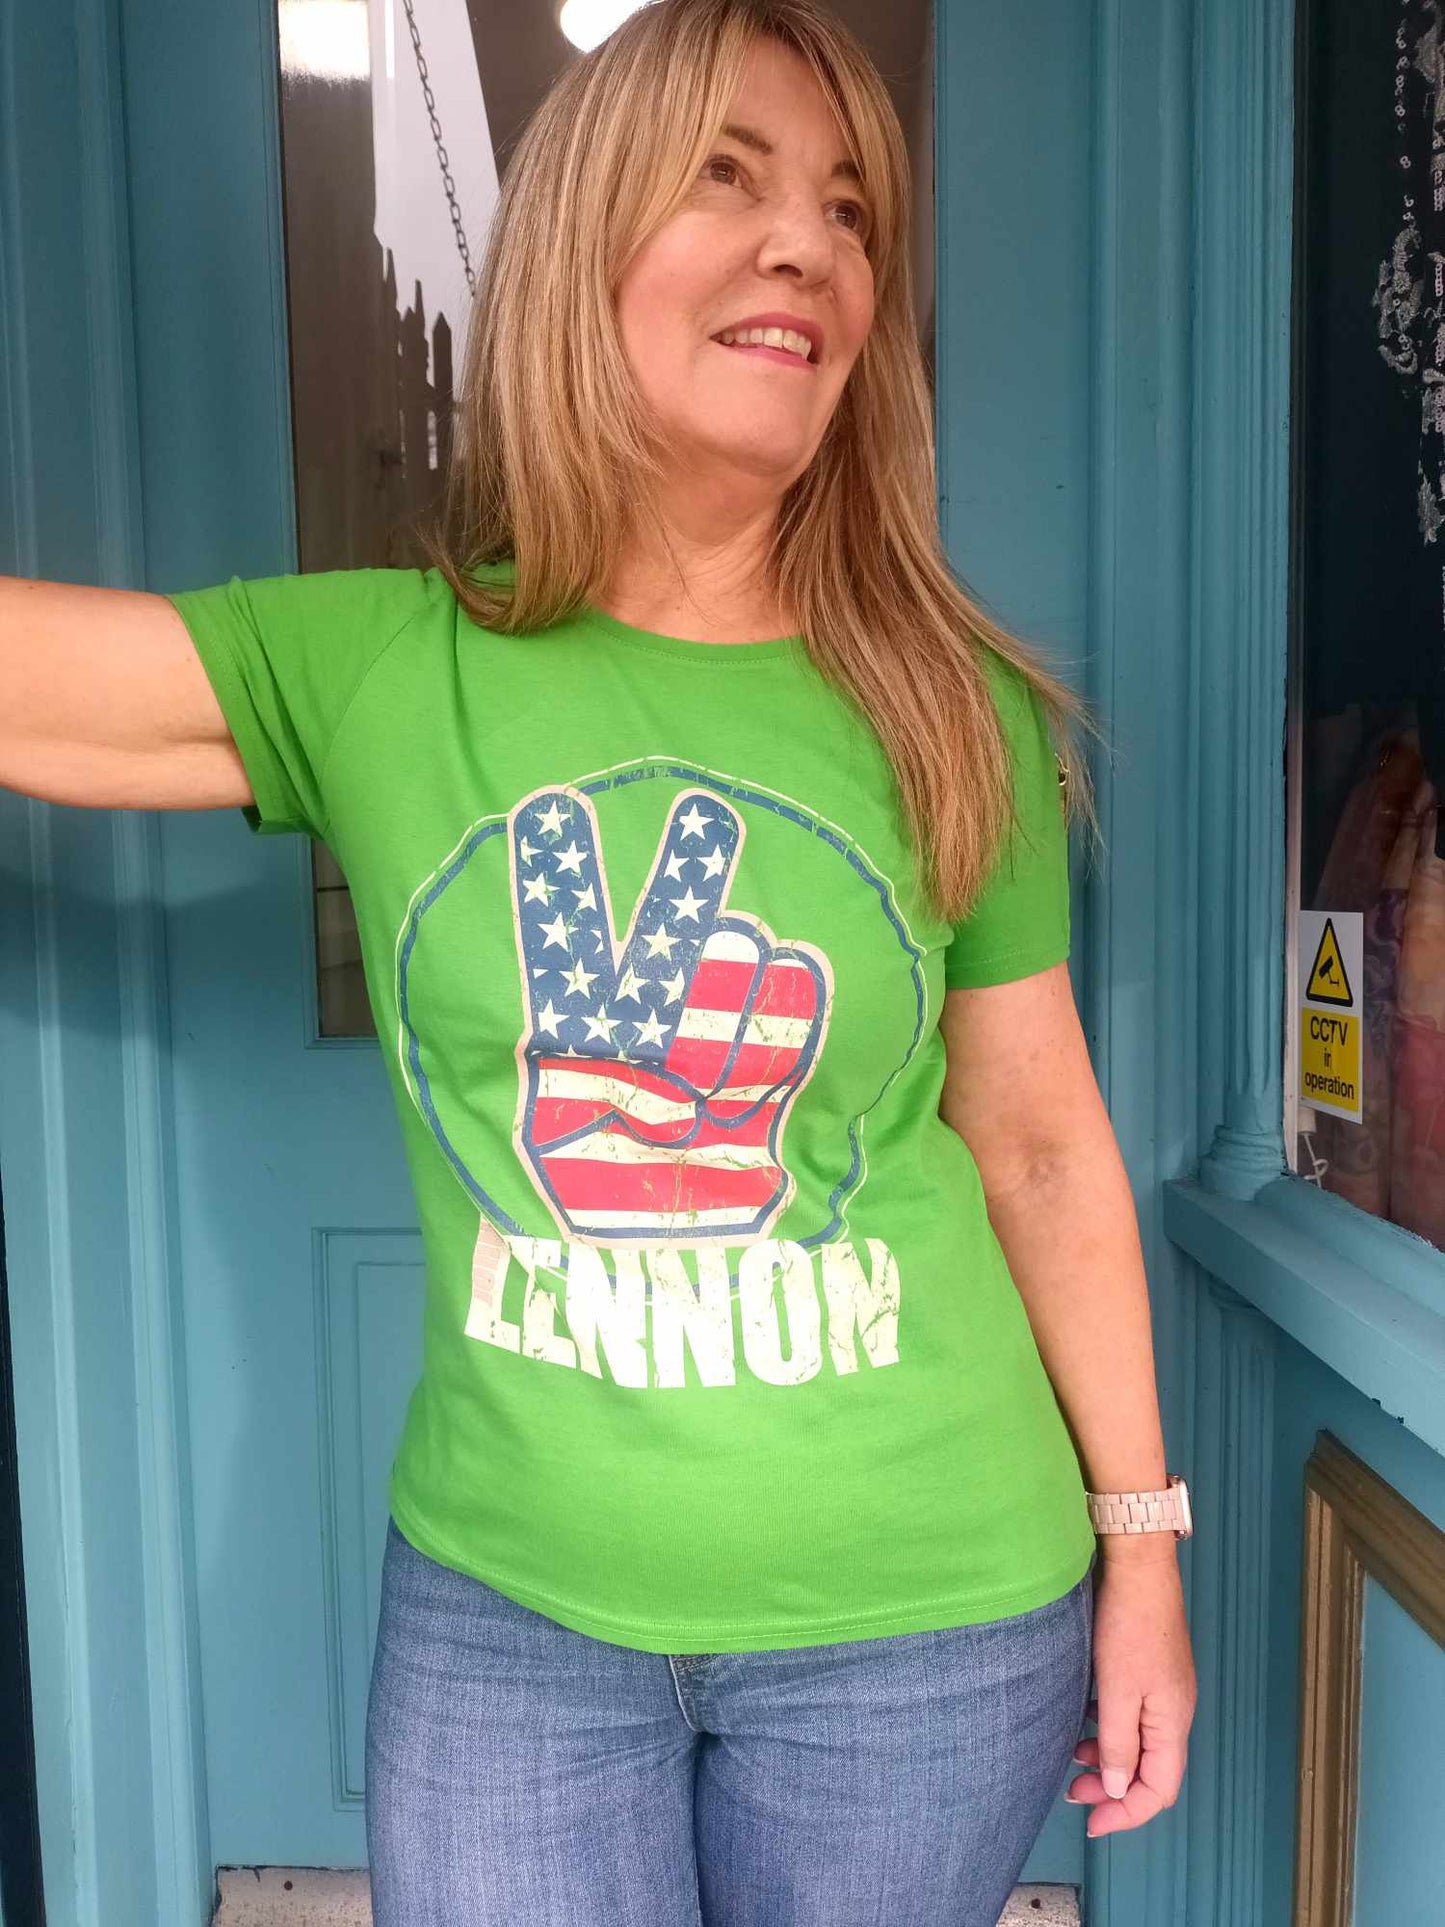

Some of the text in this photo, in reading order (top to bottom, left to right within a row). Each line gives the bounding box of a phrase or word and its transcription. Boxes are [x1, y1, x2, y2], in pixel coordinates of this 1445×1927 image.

[1310, 1016, 1348, 1046] CCTV
[1324, 1047, 1333, 1070] in
[1304, 1072, 1355, 1100] operation
[464, 1212, 901, 1389] LENNON
